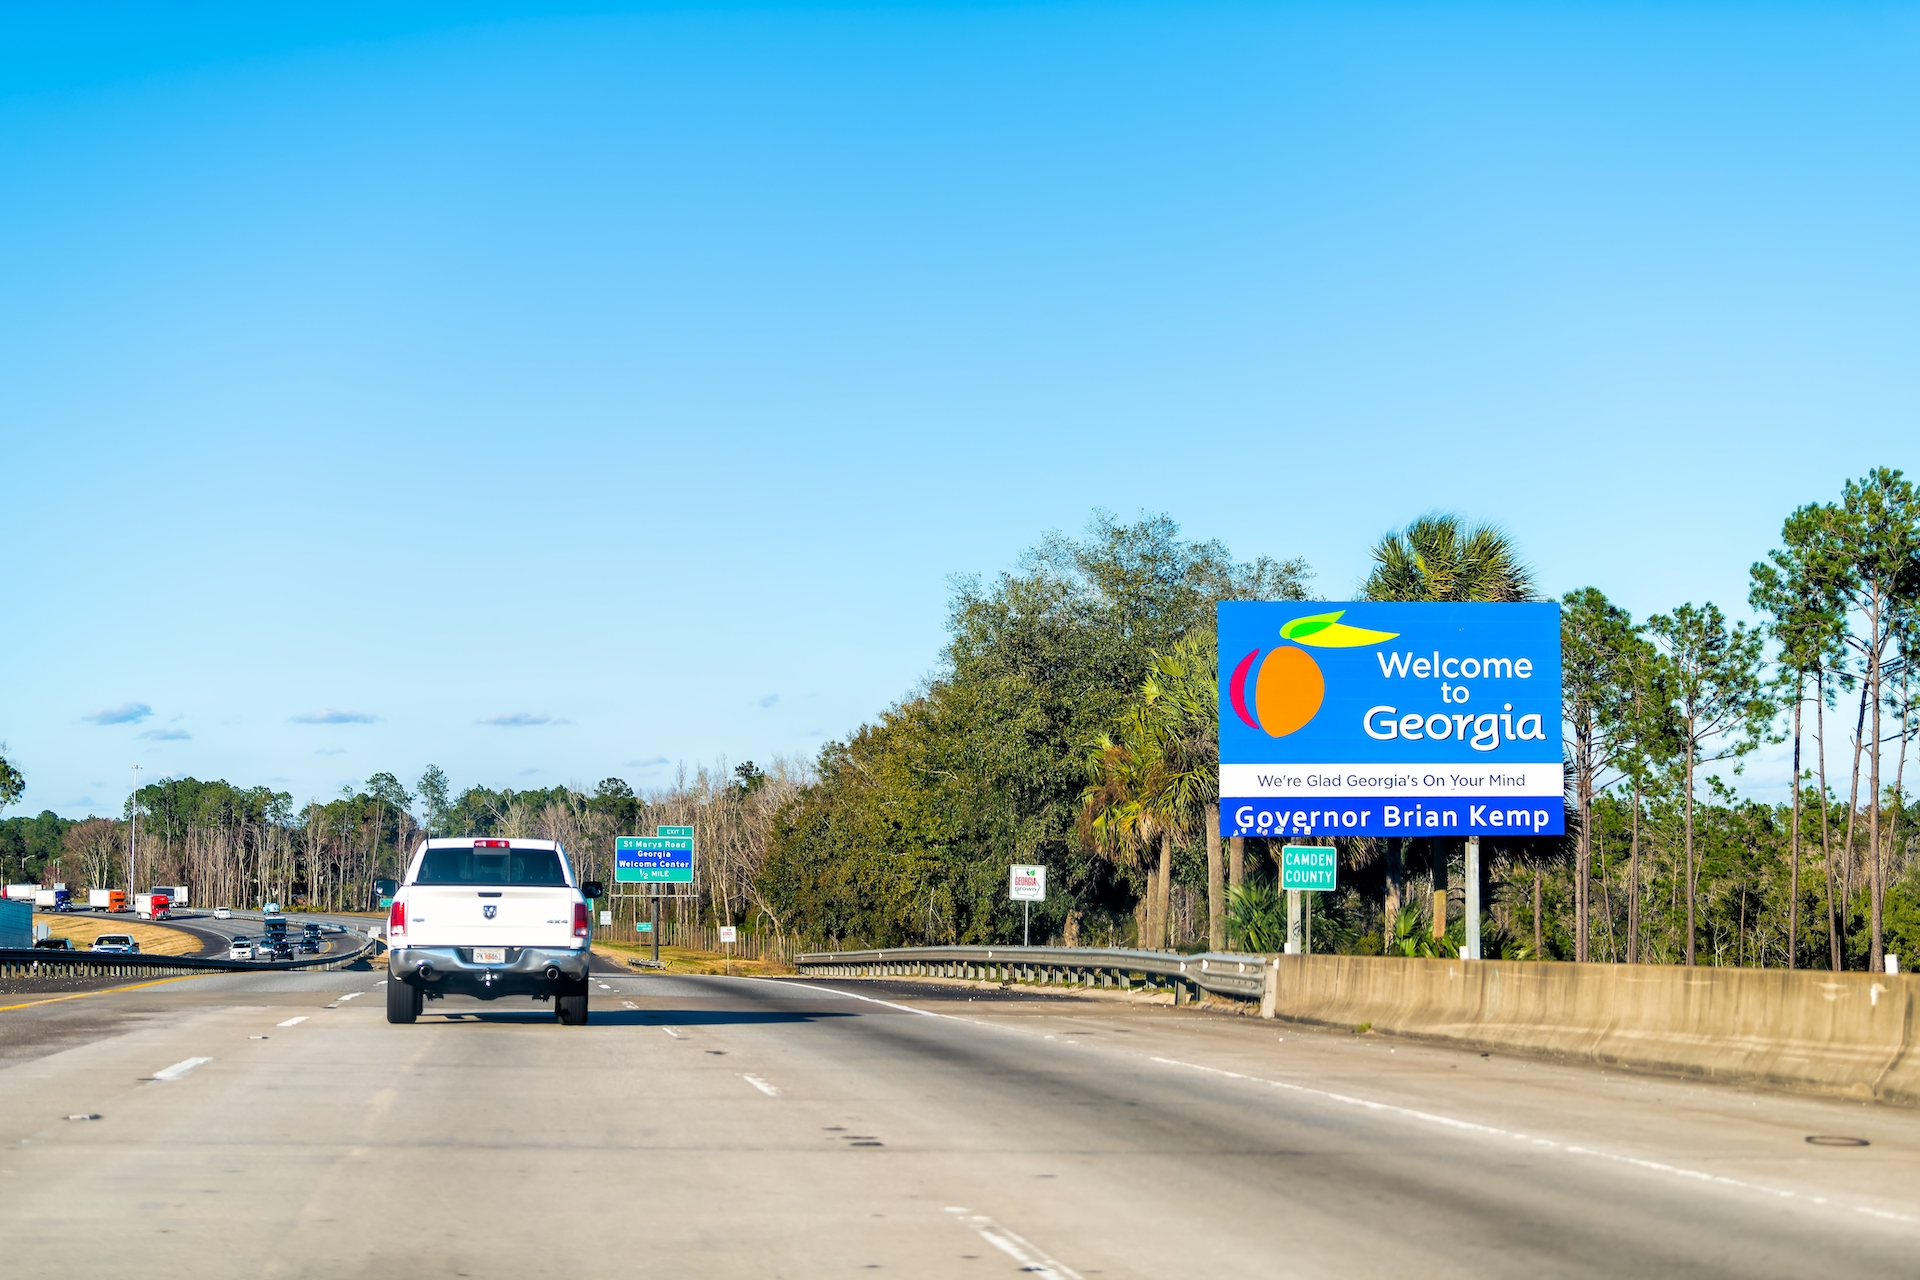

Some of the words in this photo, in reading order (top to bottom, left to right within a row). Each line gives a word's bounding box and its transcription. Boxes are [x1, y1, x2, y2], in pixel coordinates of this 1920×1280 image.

[1377, 651, 1533, 679] Welcome
[1441, 682, 1470, 704] to
[1363, 703, 1546, 752] Georgia
[1257, 774, 1302, 787] We're
[1307, 774, 1342, 787] Glad
[1346, 774, 1419, 789] Georgia's
[1422, 774, 1446, 787] On
[1450, 774, 1487, 787] Your
[1489, 774, 1526, 787] Mind
[1234, 806, 1371, 828] Governor
[1384, 804, 1458, 828] Brian
[1470, 805, 1549, 833] Kemp
[636, 841, 663, 849] Marys
[637, 850, 671, 859] Georgia
[1285, 852, 1334, 867] CAMDEN
[619, 860, 657, 868] Welcome
[659, 860, 690, 868] Center
[1015, 877, 1036, 886] GEORGIA
[1285, 870, 1333, 885] COUNTY
